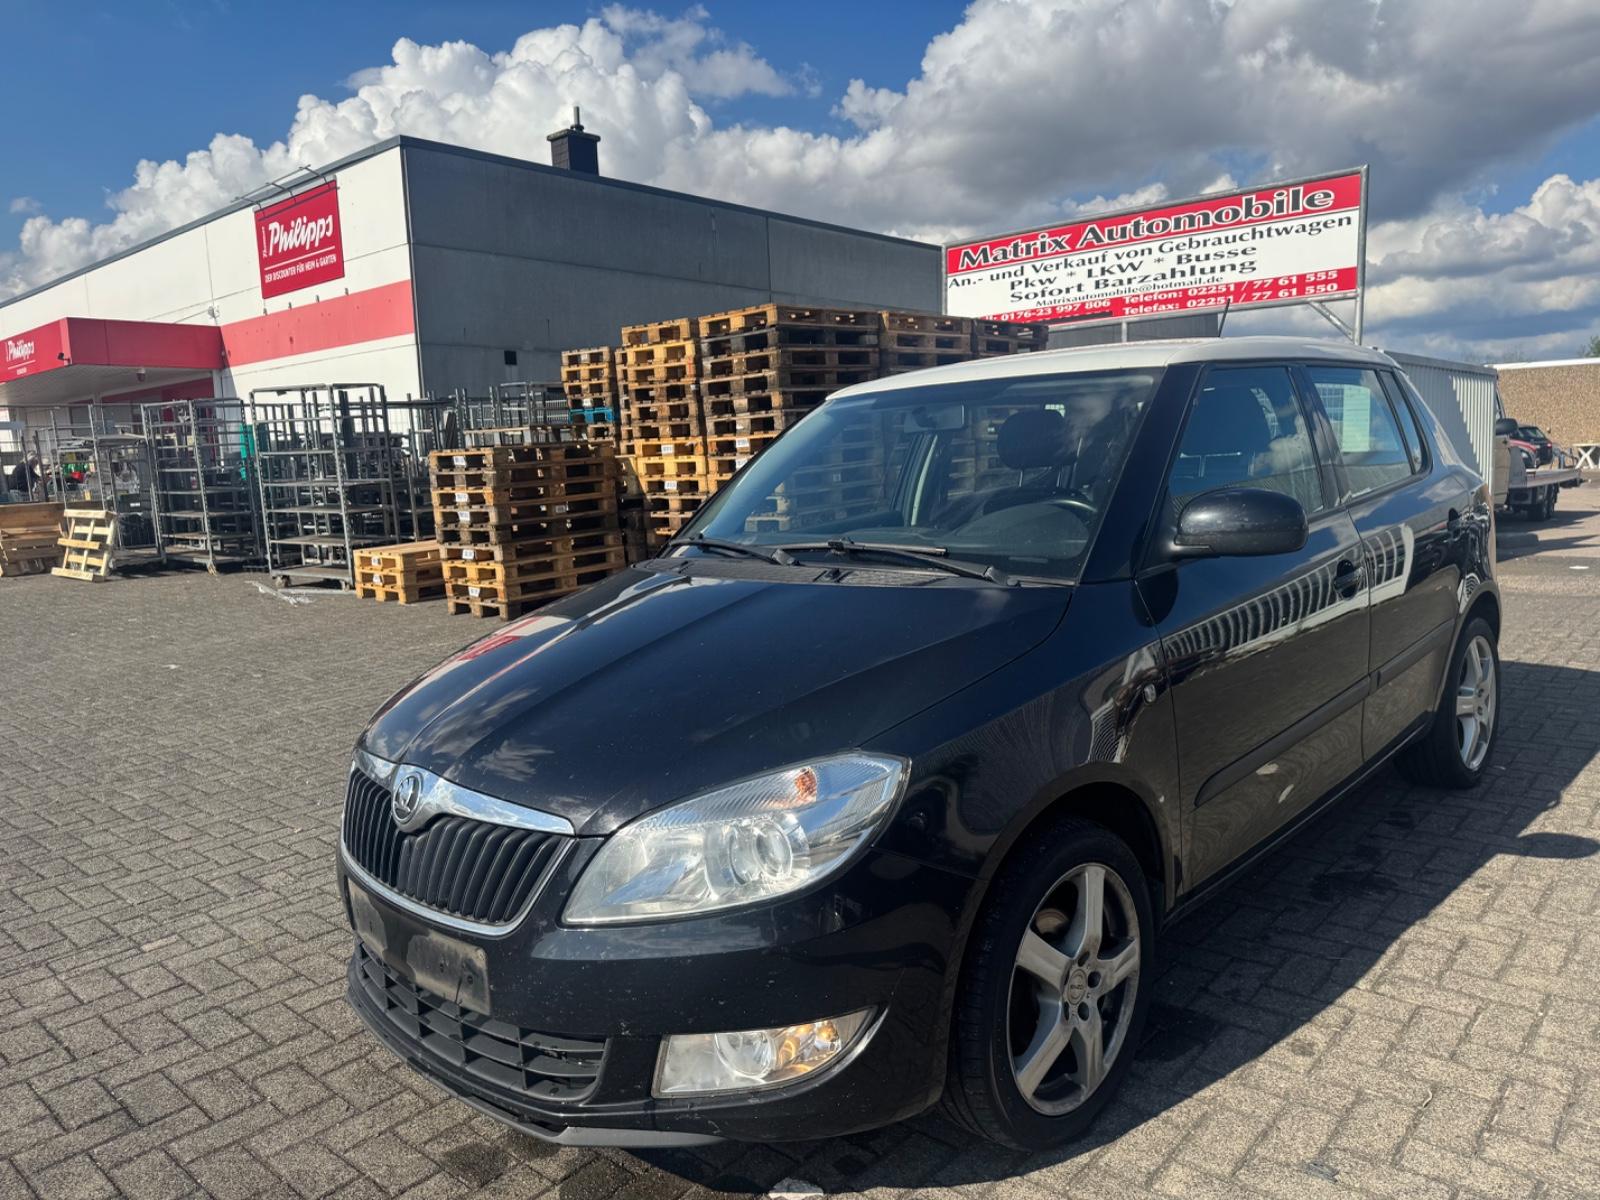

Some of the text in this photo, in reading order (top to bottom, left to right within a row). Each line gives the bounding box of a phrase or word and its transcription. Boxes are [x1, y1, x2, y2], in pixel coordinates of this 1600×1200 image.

[269, 215, 333, 256] Philipps
[958, 187, 1334, 270] Matrix Automobile
[990, 266, 1025, 282] und
[1032, 250, 1109, 273] Verkauf
[1114, 246, 1152, 260] von
[1159, 216, 1352, 252] Gebrauchtwagen
[1010, 260, 1257, 302] Sofort Barzahlung
[1087, 260, 1143, 279] LKW
[1177, 246, 1257, 265] Busse
[1000, 307, 1053, 321] 0176-23
[1056, 303, 1081, 314] 997
[1085, 299, 1111, 309] 806
[1122, 288, 1183, 304] Telefon:
[1188, 283, 1236, 297] 02251
[1253, 279, 1274, 289] 77
[1278, 276, 1298, 285] 61
[1304, 270, 1338, 282] 555
[1036, 276, 1223, 307] Matrixautomobile@hotmail.de
[1122, 303, 1180, 315] Telefax:
[1186, 295, 1234, 308] 02251
[1252, 291, 1273, 300] 77
[1278, 288, 1297, 297] 61
[1304, 283, 1338, 294] 550
